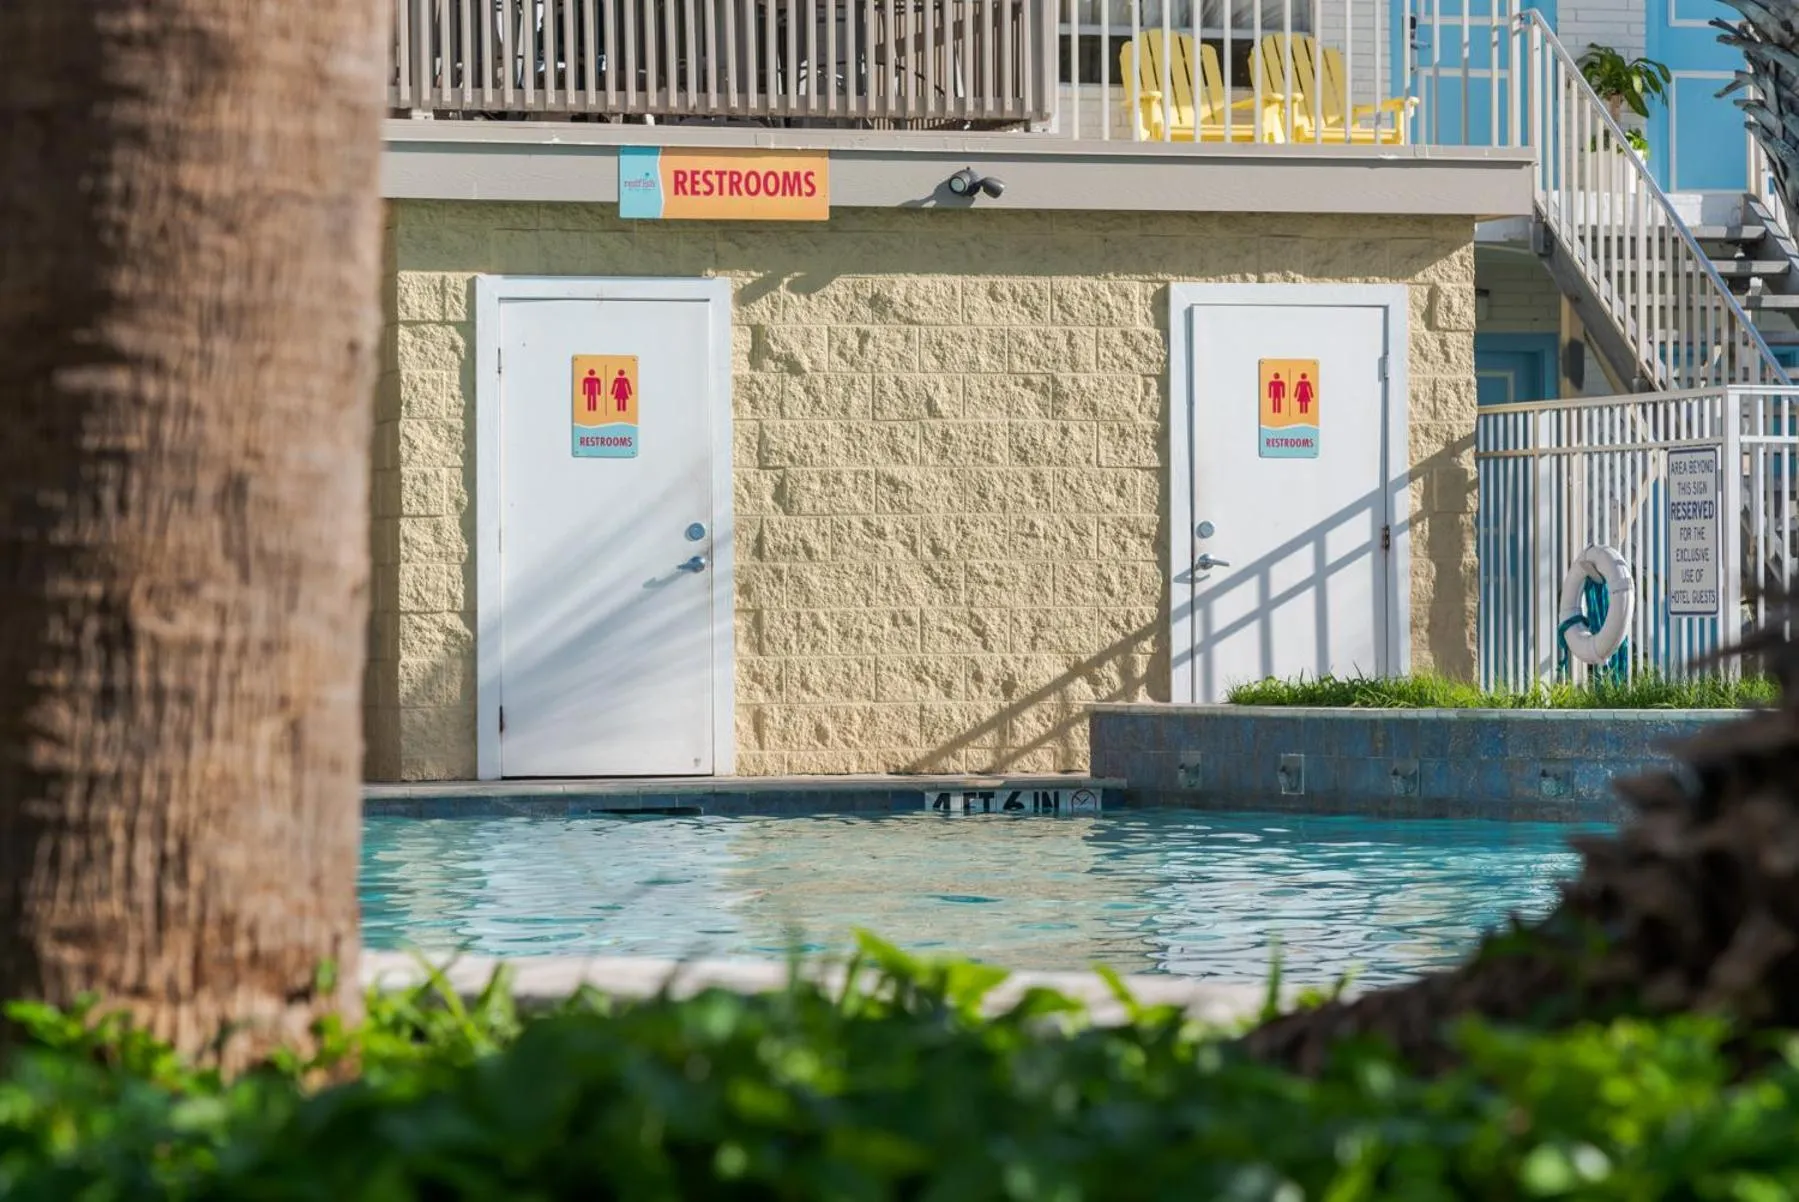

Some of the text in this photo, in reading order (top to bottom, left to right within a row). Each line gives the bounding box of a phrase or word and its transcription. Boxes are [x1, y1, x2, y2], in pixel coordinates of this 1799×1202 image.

[673, 170, 816, 197] RESTROOMS
[580, 436, 633, 447] RESTROOMS
[1266, 438, 1314, 448] RESTROOMS
[1671, 459, 1714, 475] AREA BEYOND
[1677, 480, 1708, 495] THIS SIGN
[1671, 501, 1714, 520] RESERVED
[1680, 526, 1706, 540] FOR THE
[1676, 547, 1710, 562] EXCLUSIVE
[1682, 568, 1704, 583] USE OF
[1671, 589, 1716, 604] HOTEL GUESTS
[932, 791, 1059, 815] 4 FT 6 IN
